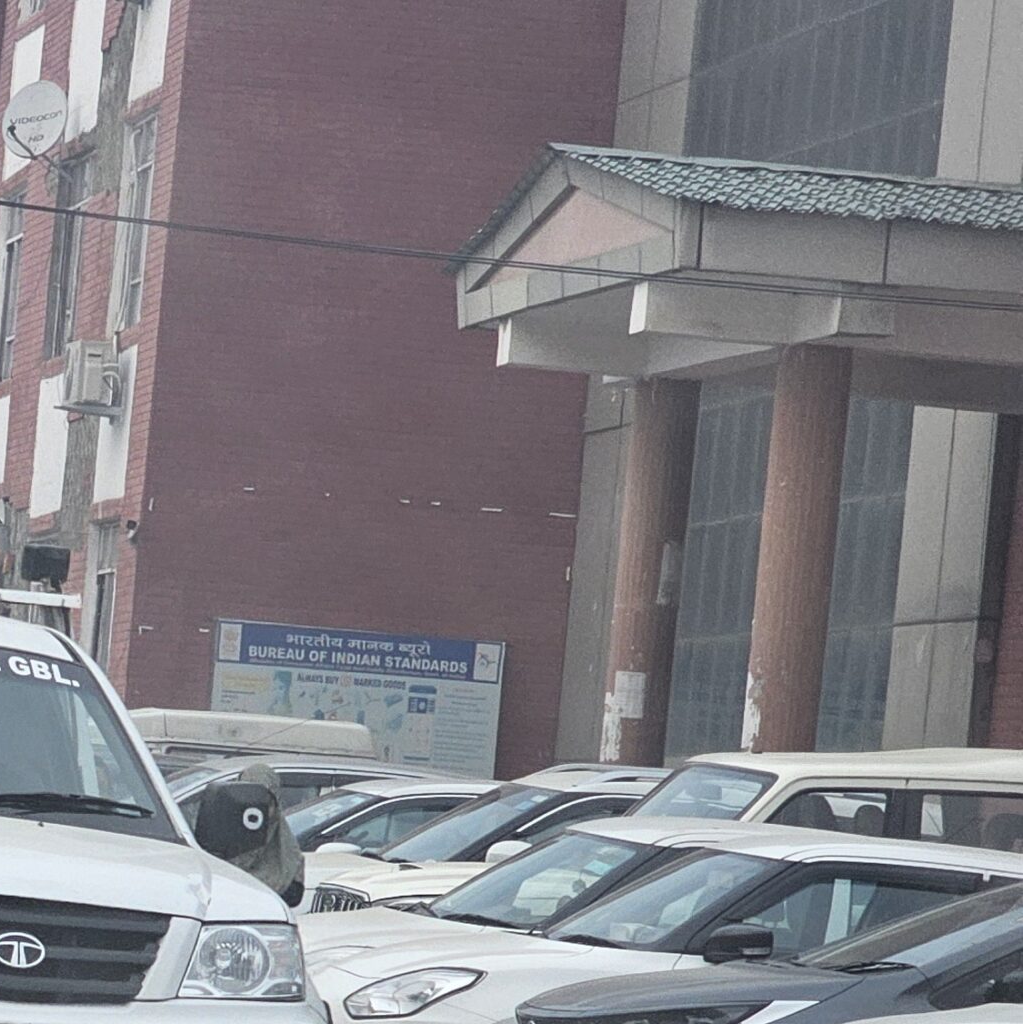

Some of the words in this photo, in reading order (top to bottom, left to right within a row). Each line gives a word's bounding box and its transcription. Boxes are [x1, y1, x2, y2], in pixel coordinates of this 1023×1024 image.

[285, 633, 343, 650] भारतीय
[347, 639, 394, 653] मानक
[8, 655, 81, 687] GBL.
[248, 644, 306, 661] BUREAU
[309, 649, 328, 663] OF
[331, 652, 381, 667] INDIAN
[384, 655, 468, 674] STANDARDS
